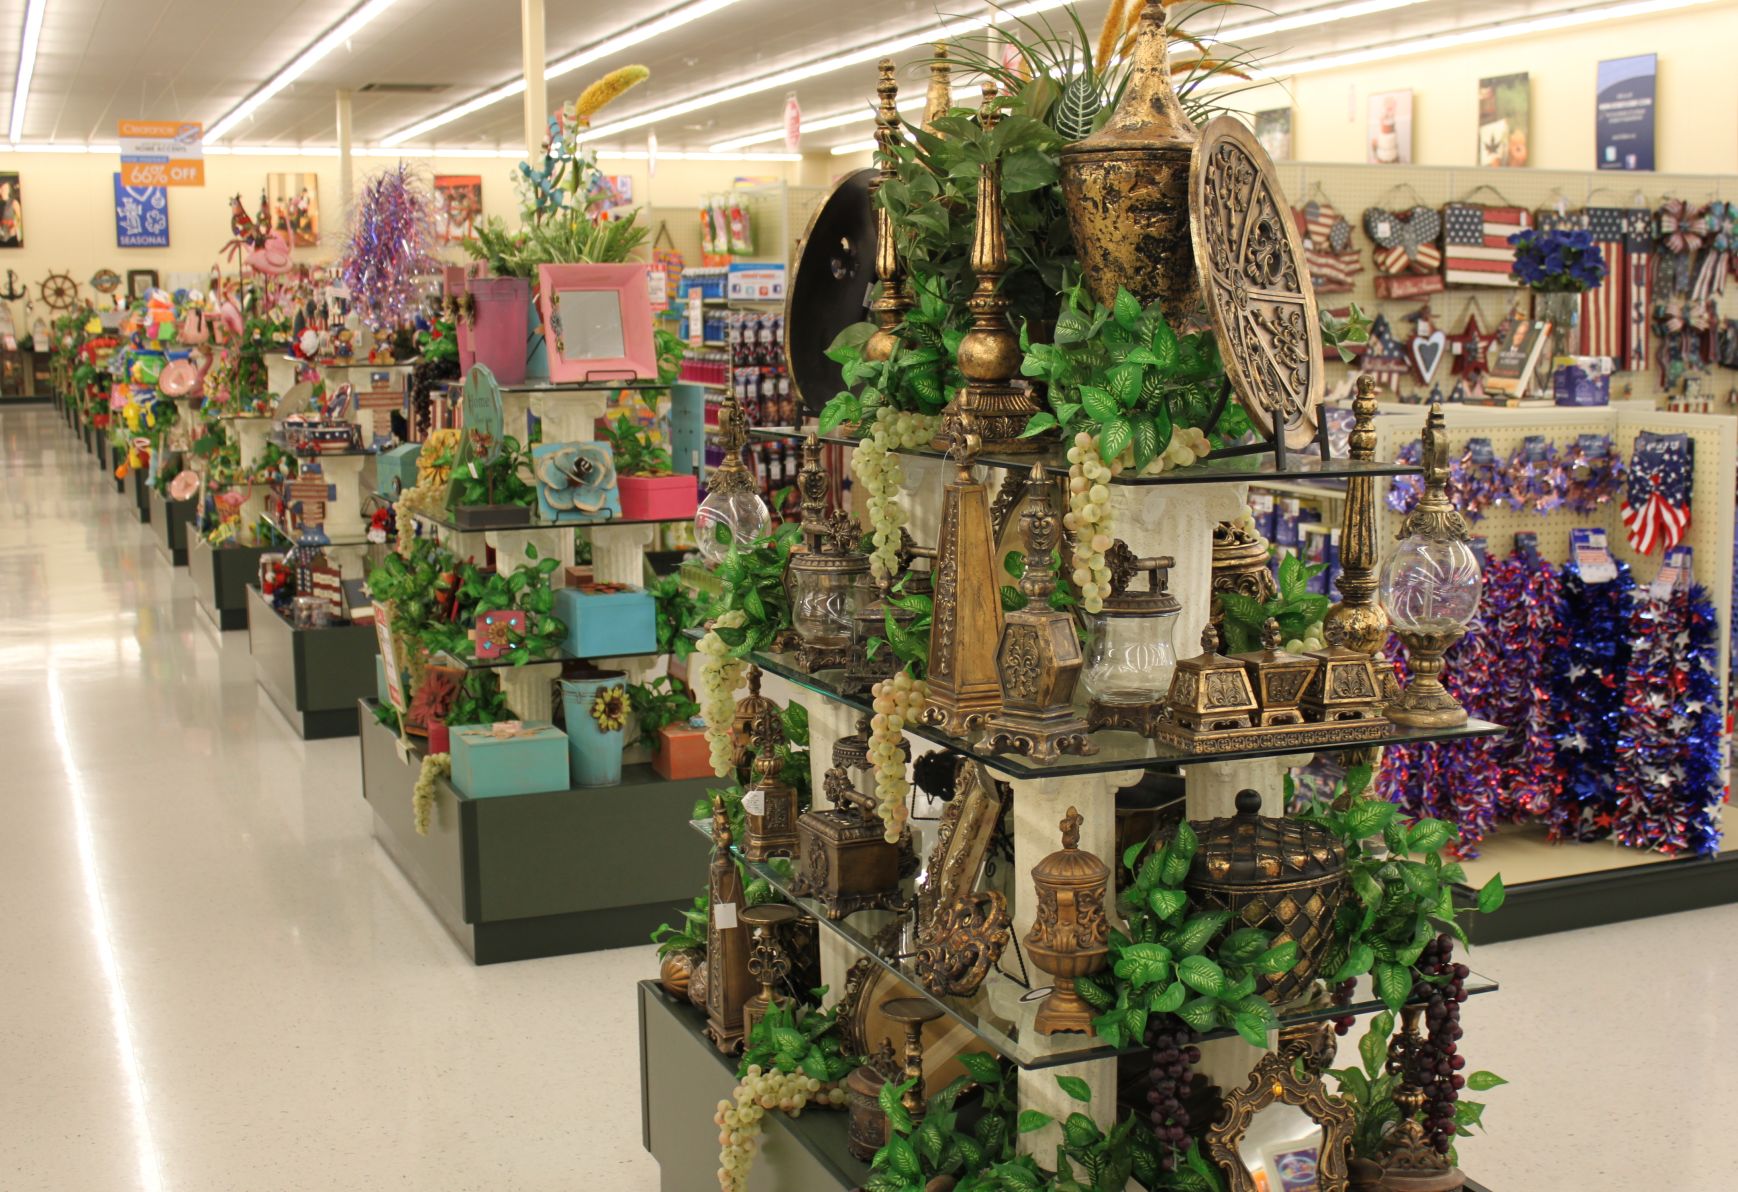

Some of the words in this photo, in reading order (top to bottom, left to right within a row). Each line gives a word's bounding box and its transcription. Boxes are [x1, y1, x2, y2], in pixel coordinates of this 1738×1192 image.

[131, 165, 168, 183] 66%
[170, 166, 197, 180] OFF
[120, 236, 167, 246] SEASONAL
